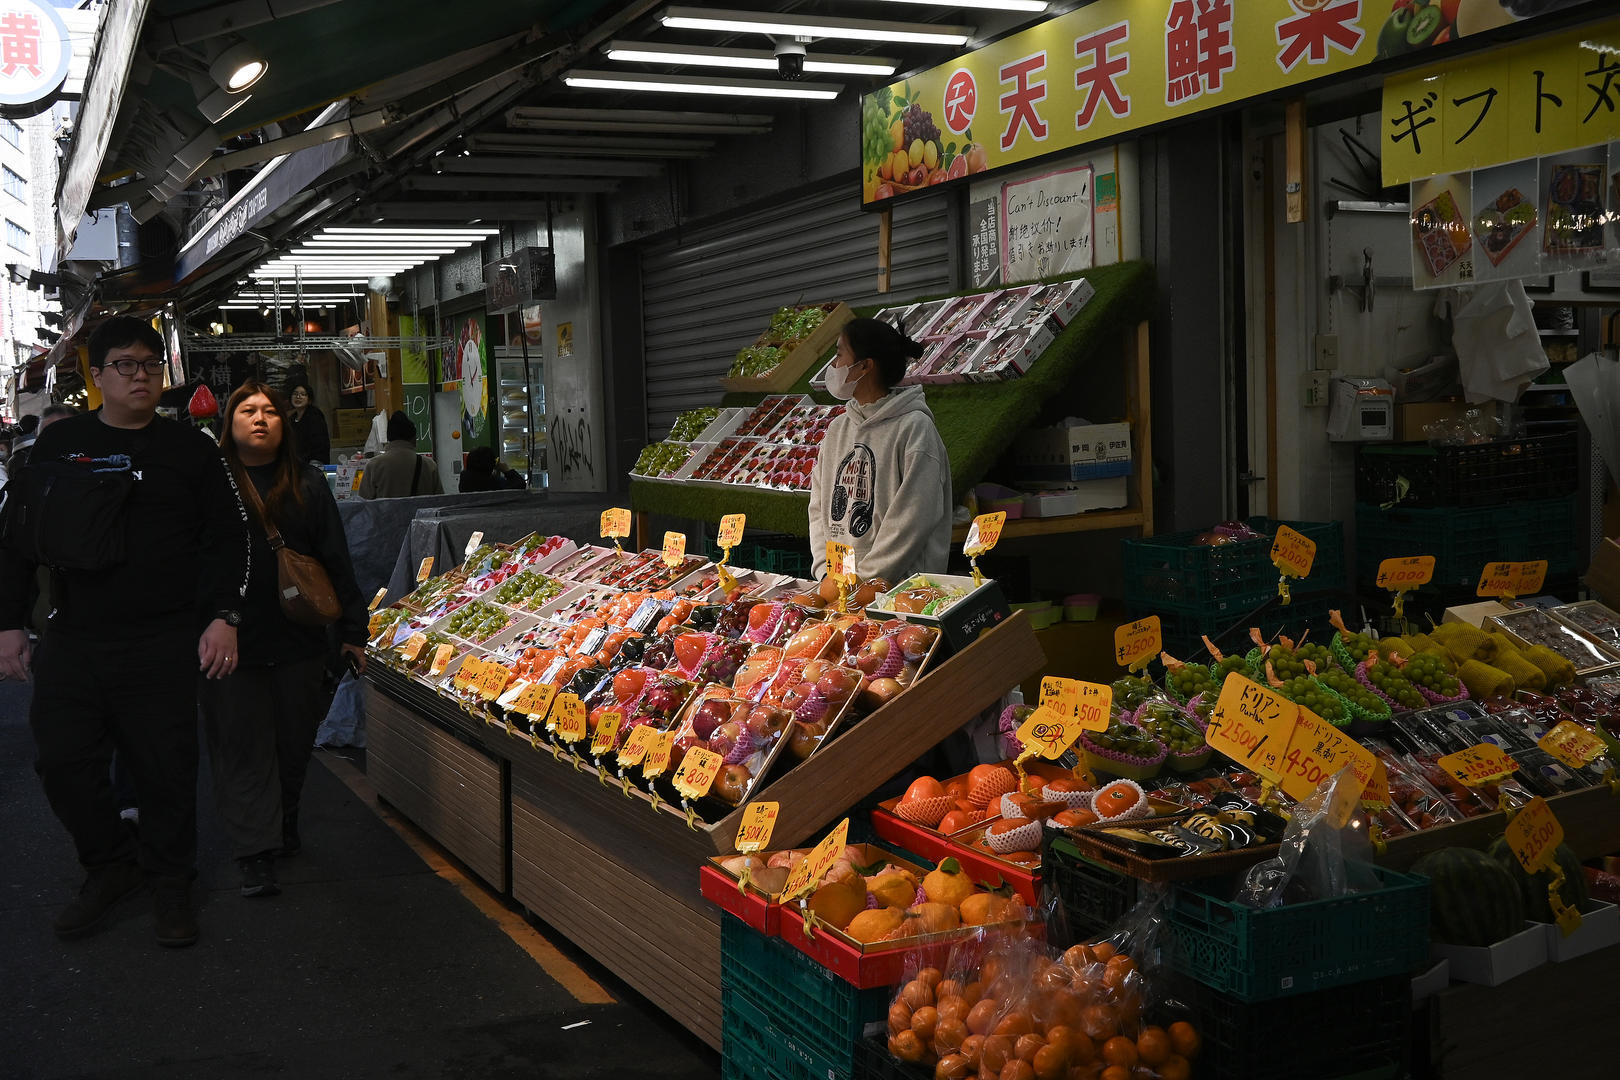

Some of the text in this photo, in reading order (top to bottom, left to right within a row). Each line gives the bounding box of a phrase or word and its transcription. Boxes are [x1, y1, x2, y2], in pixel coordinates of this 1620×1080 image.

[0, 12, 42, 77] 黄
[1008, 195, 1034, 215] Can't
[1037, 183, 1087, 208] Discount!
[987, 198, 997, 256] 当店商品
[972, 234, 982, 286] 承ります
[980, 218, 990, 271] 全国発送
[1240, 685, 1281, 719] ドリアン
[556, 715, 579, 731] ¥800
[592, 731, 612, 747] ¥1000
[1313, 725, 1353, 758] ドリアン
[676, 766, 709, 786] ¥800
